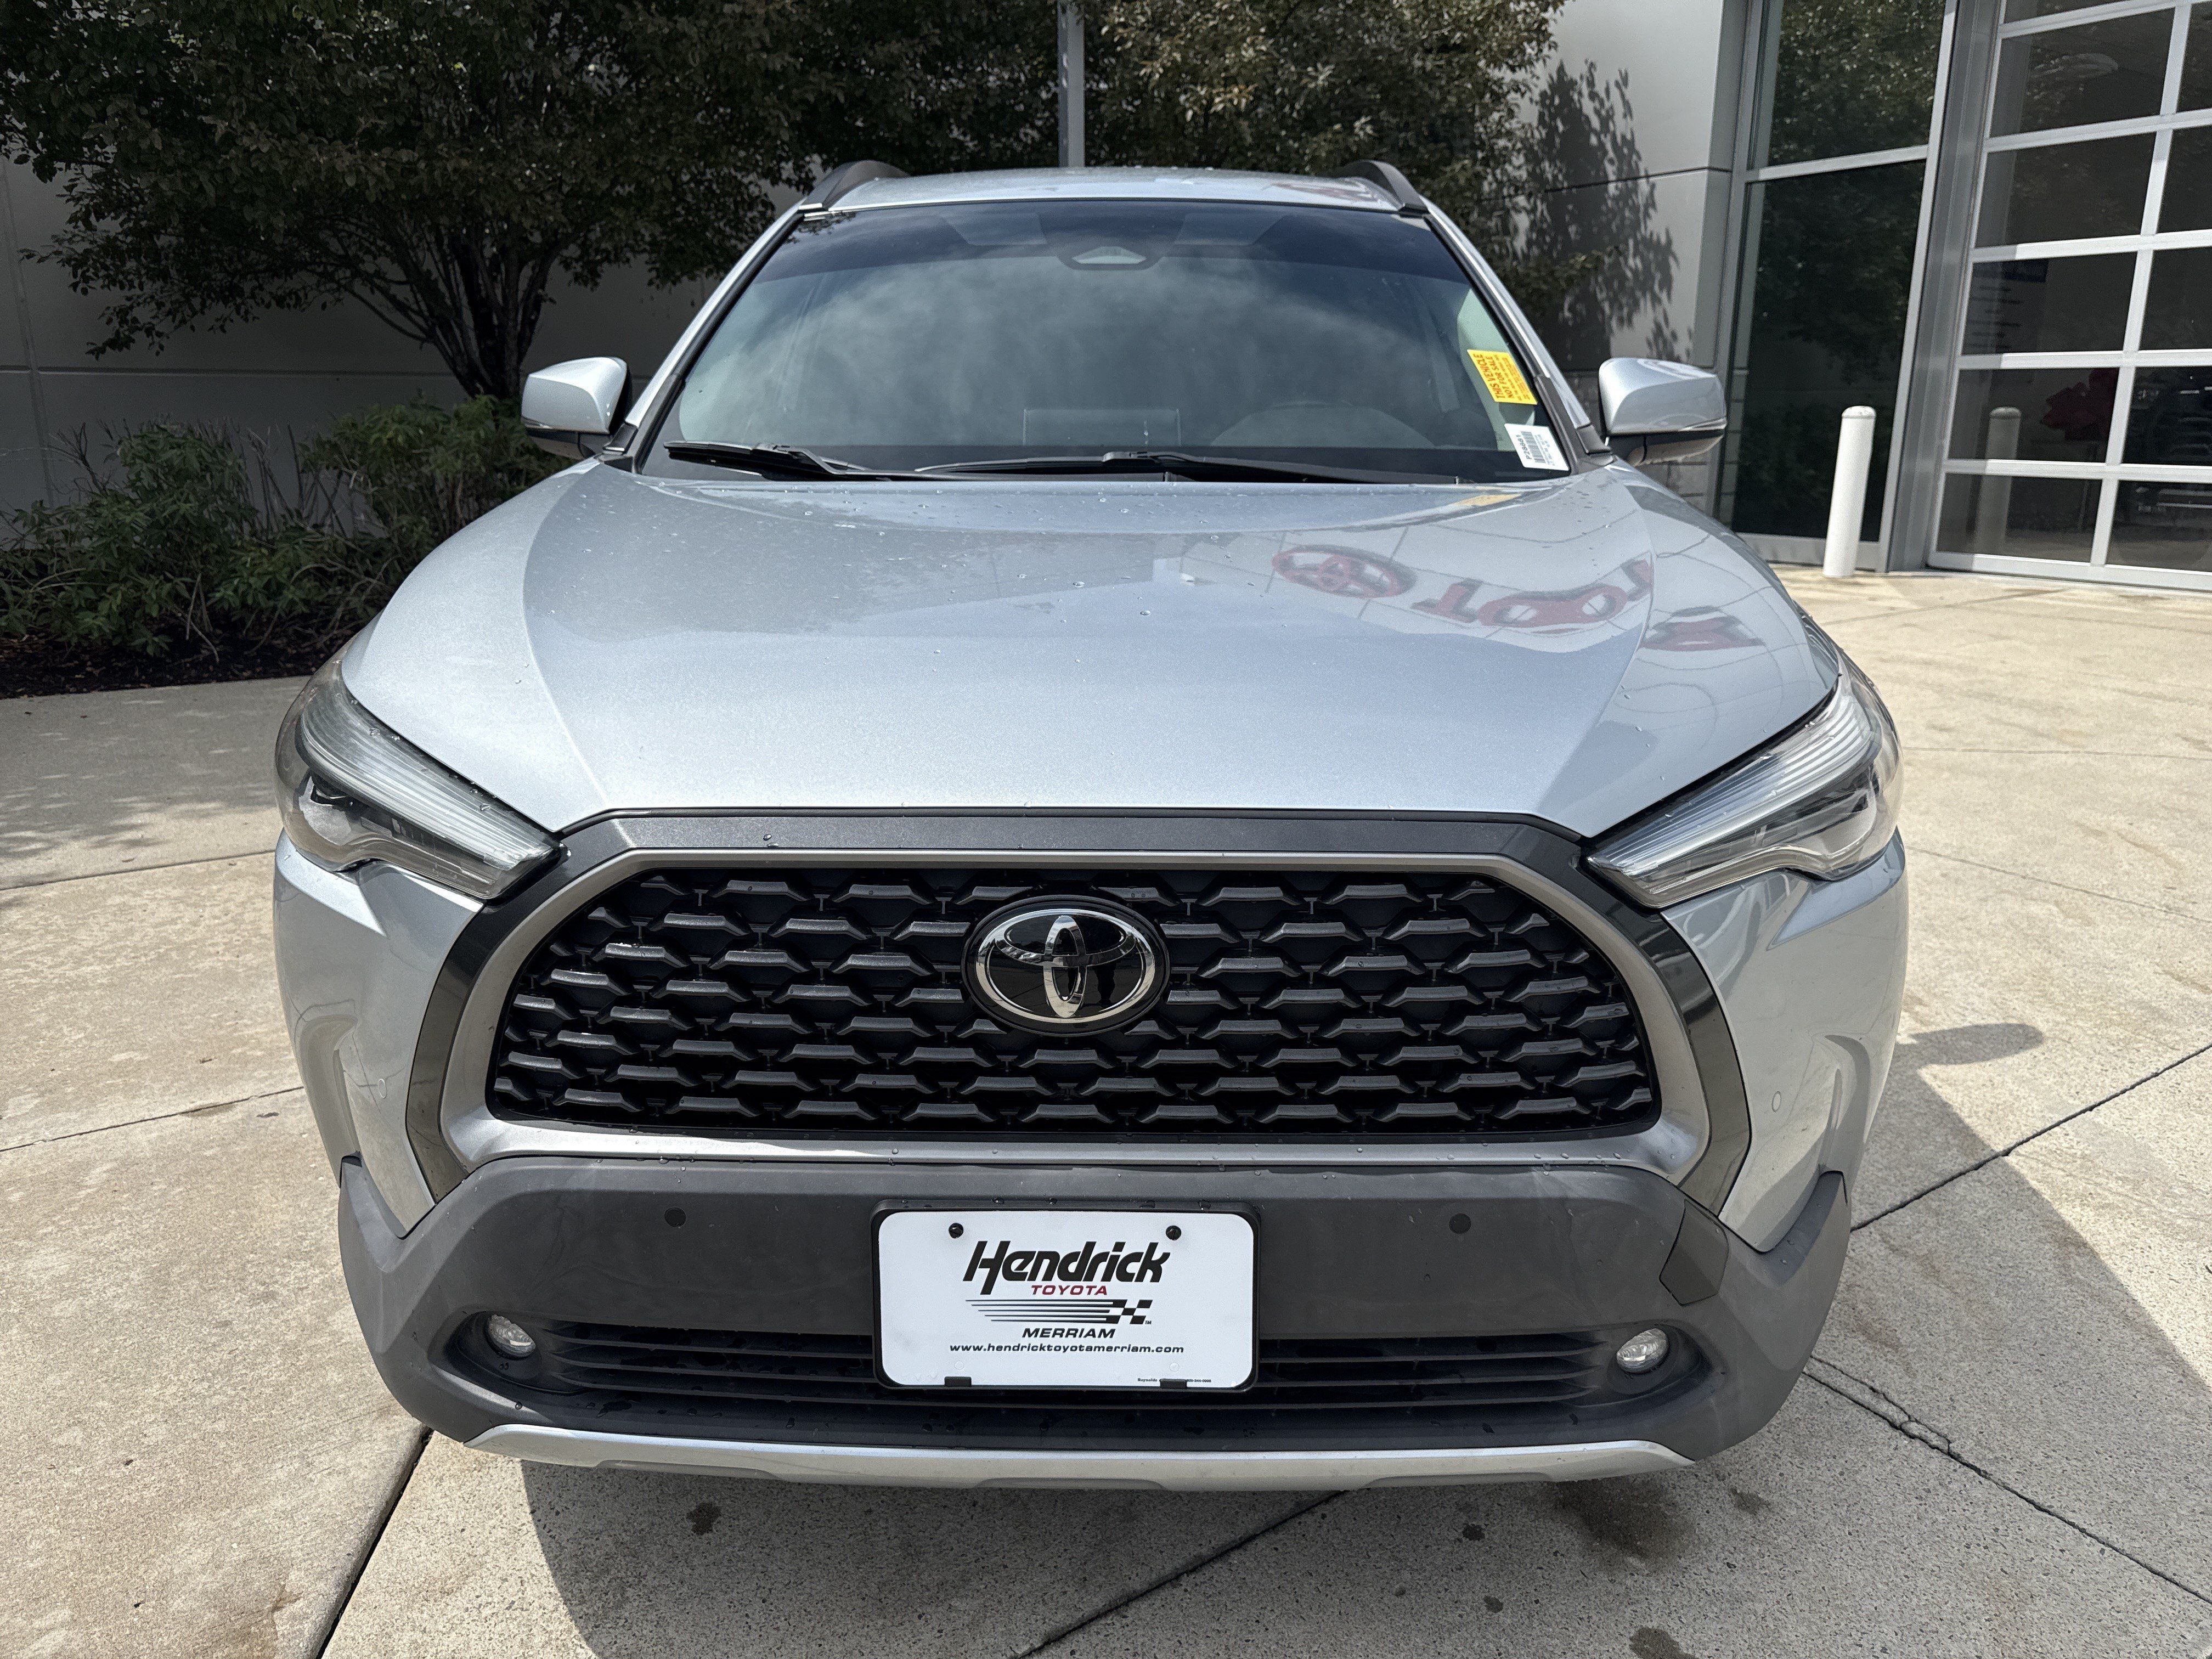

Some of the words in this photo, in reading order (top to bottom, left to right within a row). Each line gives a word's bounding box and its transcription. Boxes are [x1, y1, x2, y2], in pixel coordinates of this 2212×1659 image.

[1473, 354, 1496, 381] VEHICLE
[1485, 356, 1499, 371] SALE
[1496, 373, 1506, 384] FOR
[1490, 383, 1505, 398] THIS
[1502, 386, 1515, 398] NOT
[963, 1240, 1170, 1295] Hendrick
[1031, 1285, 1107, 1295] TOYOTA
[1022, 1328, 1116, 1339] MERRIAM
[950, 1343, 1184, 1353] www.hendricktoyotamerriam.com
